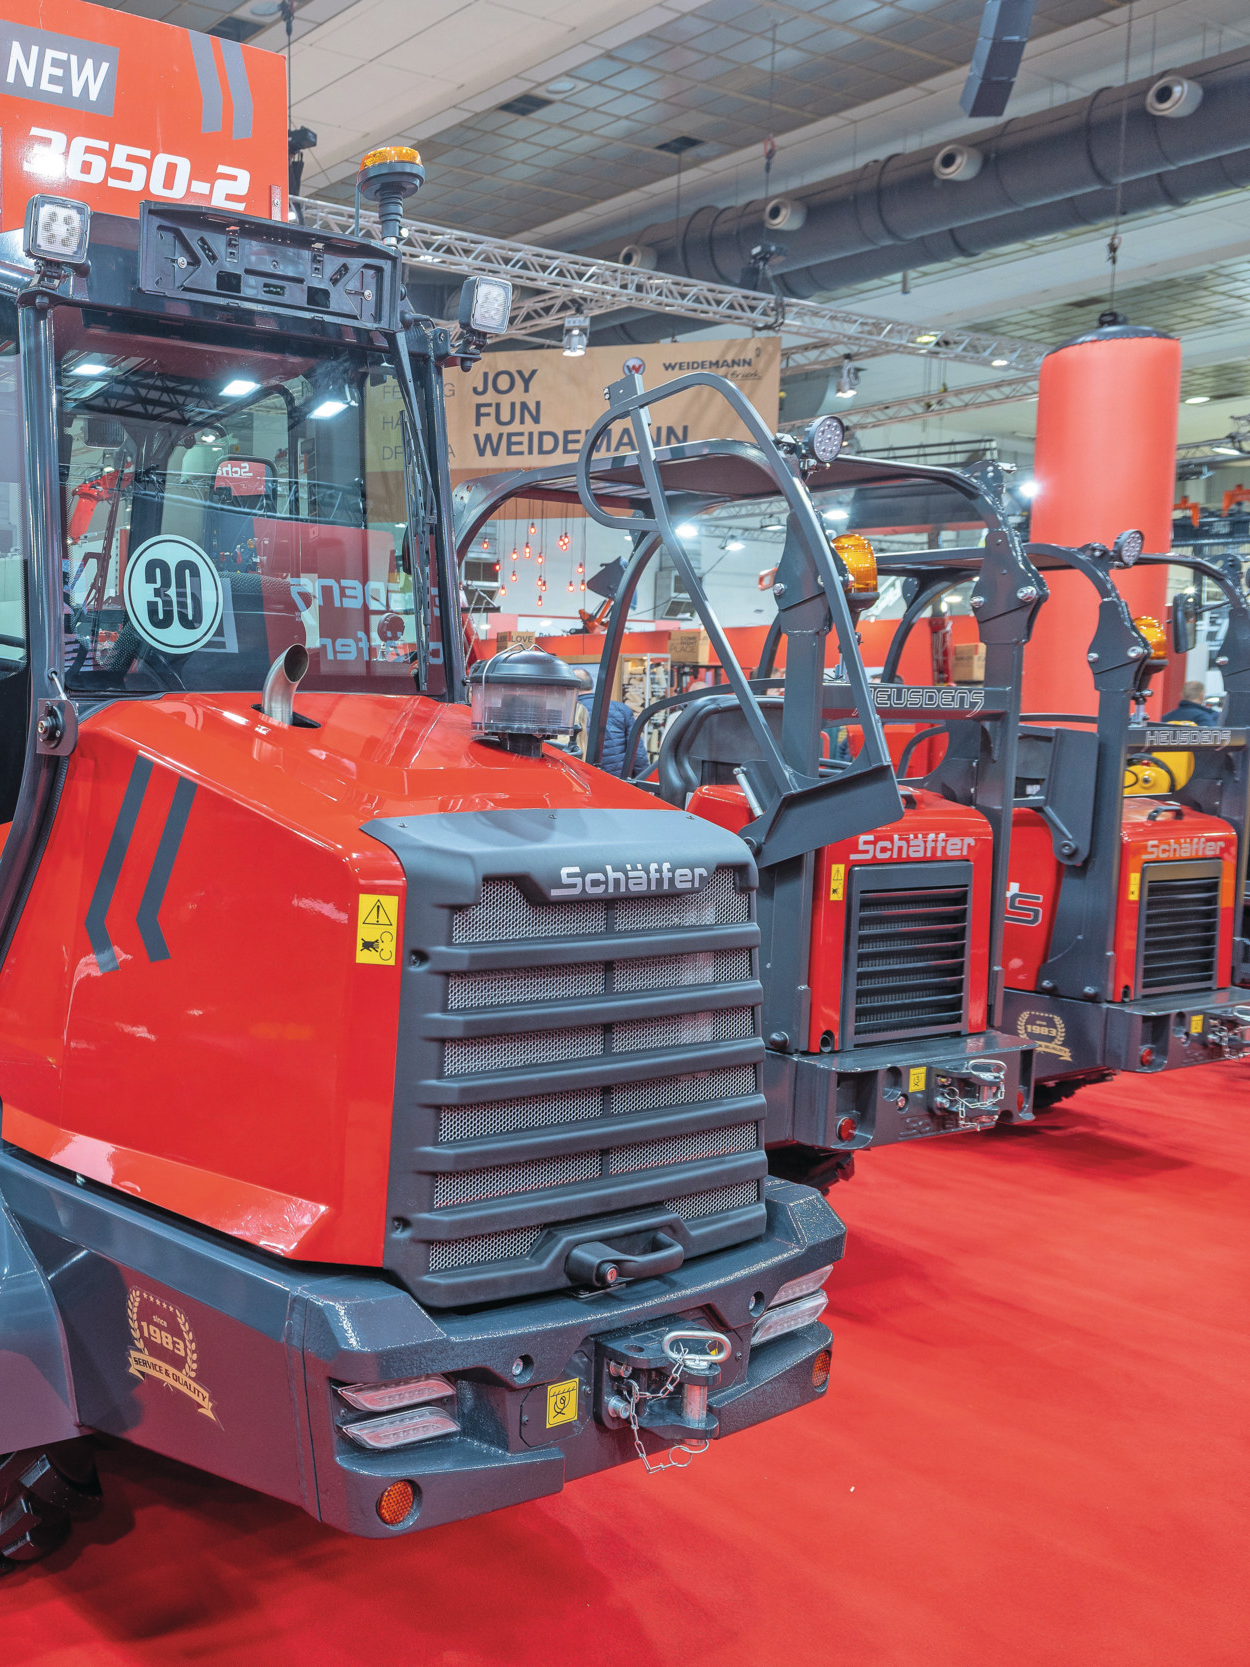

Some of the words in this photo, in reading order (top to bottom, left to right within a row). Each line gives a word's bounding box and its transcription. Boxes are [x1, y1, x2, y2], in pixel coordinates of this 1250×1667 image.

[6, 41, 110, 102] NEW
[23, 127, 251, 211] 3650-2
[662, 358, 753, 371] WEIDEMANN
[472, 368, 539, 396] JOY
[474, 400, 541, 427] FUN
[144, 557, 203, 631] 30
[511, 635, 534, 644] LOVE
[850, 833, 976, 861] Schäffer
[1141, 838, 1226, 860] Schäffer
[550, 862, 708, 896] Schäffer
[1026, 1024, 1057, 1037] 1983
[152, 1315, 168, 1327] since
[140, 1321, 186, 1357] 1983
[133, 1356, 164, 1375] SERVICE
[164, 1368, 171, 1379] &
[172, 1372, 207, 1402] QUALITY
